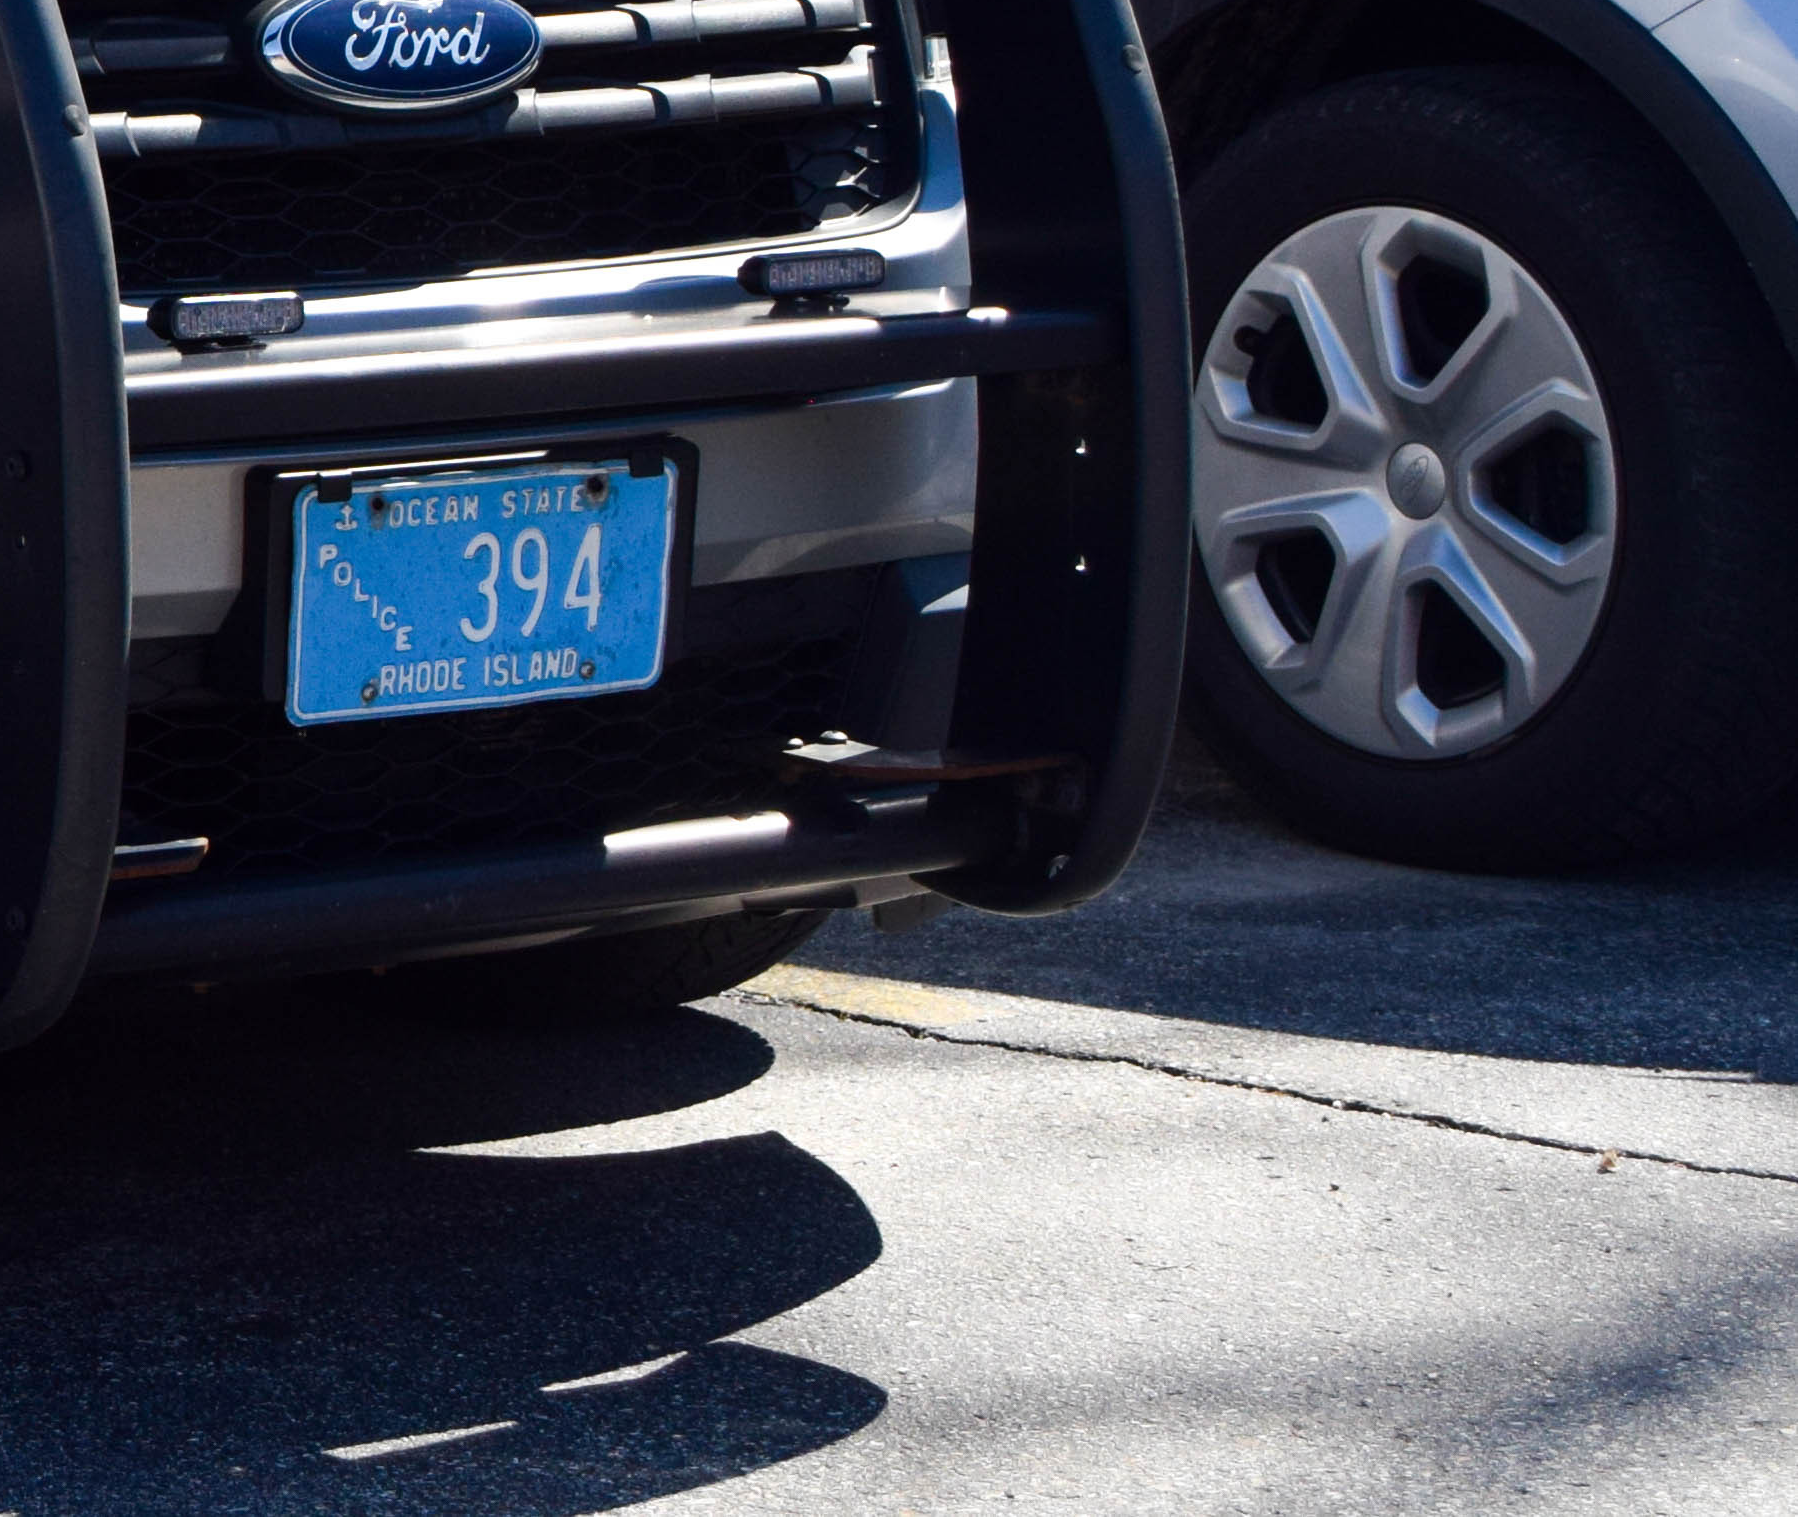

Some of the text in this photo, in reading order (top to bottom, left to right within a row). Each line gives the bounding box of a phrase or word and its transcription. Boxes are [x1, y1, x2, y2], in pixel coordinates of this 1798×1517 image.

[389, 486, 586, 528] OCEAN STATE
[318, 543, 414, 651] POLICE
[460, 523, 602, 643] 394
[377, 648, 579, 696] RHODE ISLAND
